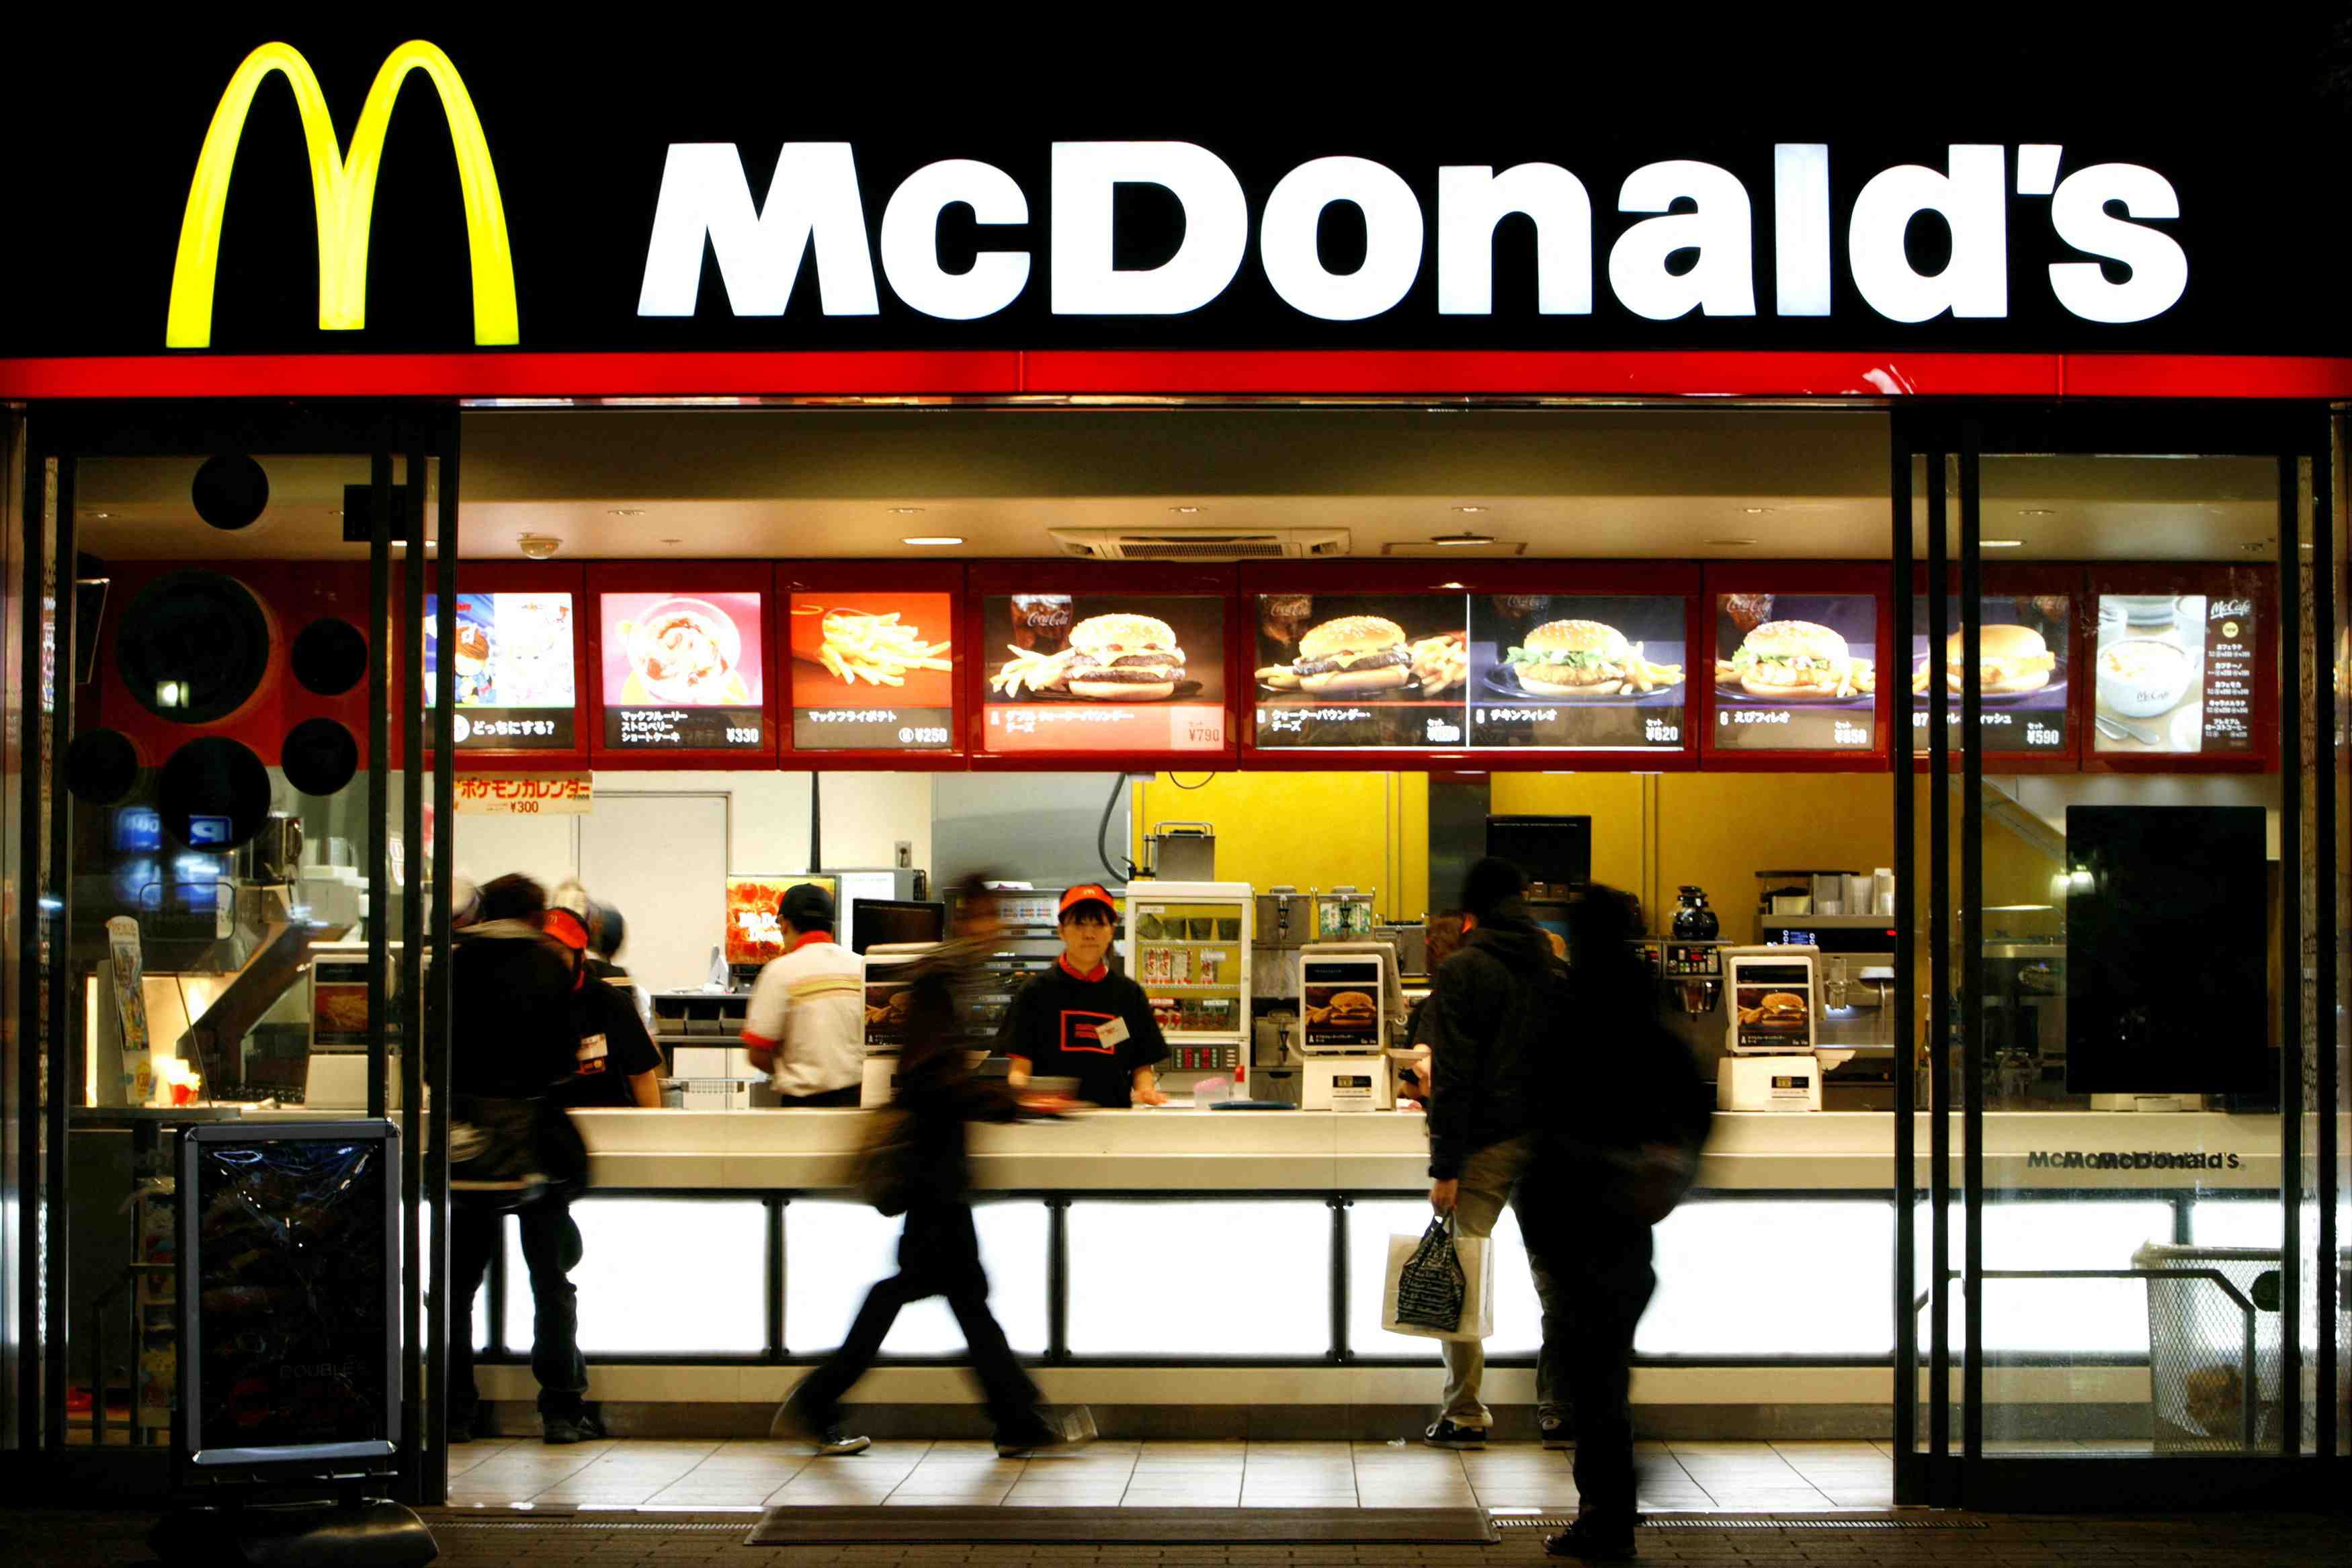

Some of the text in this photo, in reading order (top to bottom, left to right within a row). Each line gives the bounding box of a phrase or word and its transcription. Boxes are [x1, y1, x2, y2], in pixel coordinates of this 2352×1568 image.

[637, 141, 2189, 323] McDonald's
[620, 710, 689, 722] マックフルーリー
[808, 710, 898, 723] マックフライポテト
[621, 722, 674, 732] ストロベリー
[622, 732, 681, 742] ショートケーキ
[1189, 728, 1220, 742] ¥790
[2027, 730, 2060, 744] ¥590
[461, 778, 591, 798] ポケモンカレンダー
[510, 801, 539, 813] ¥300
